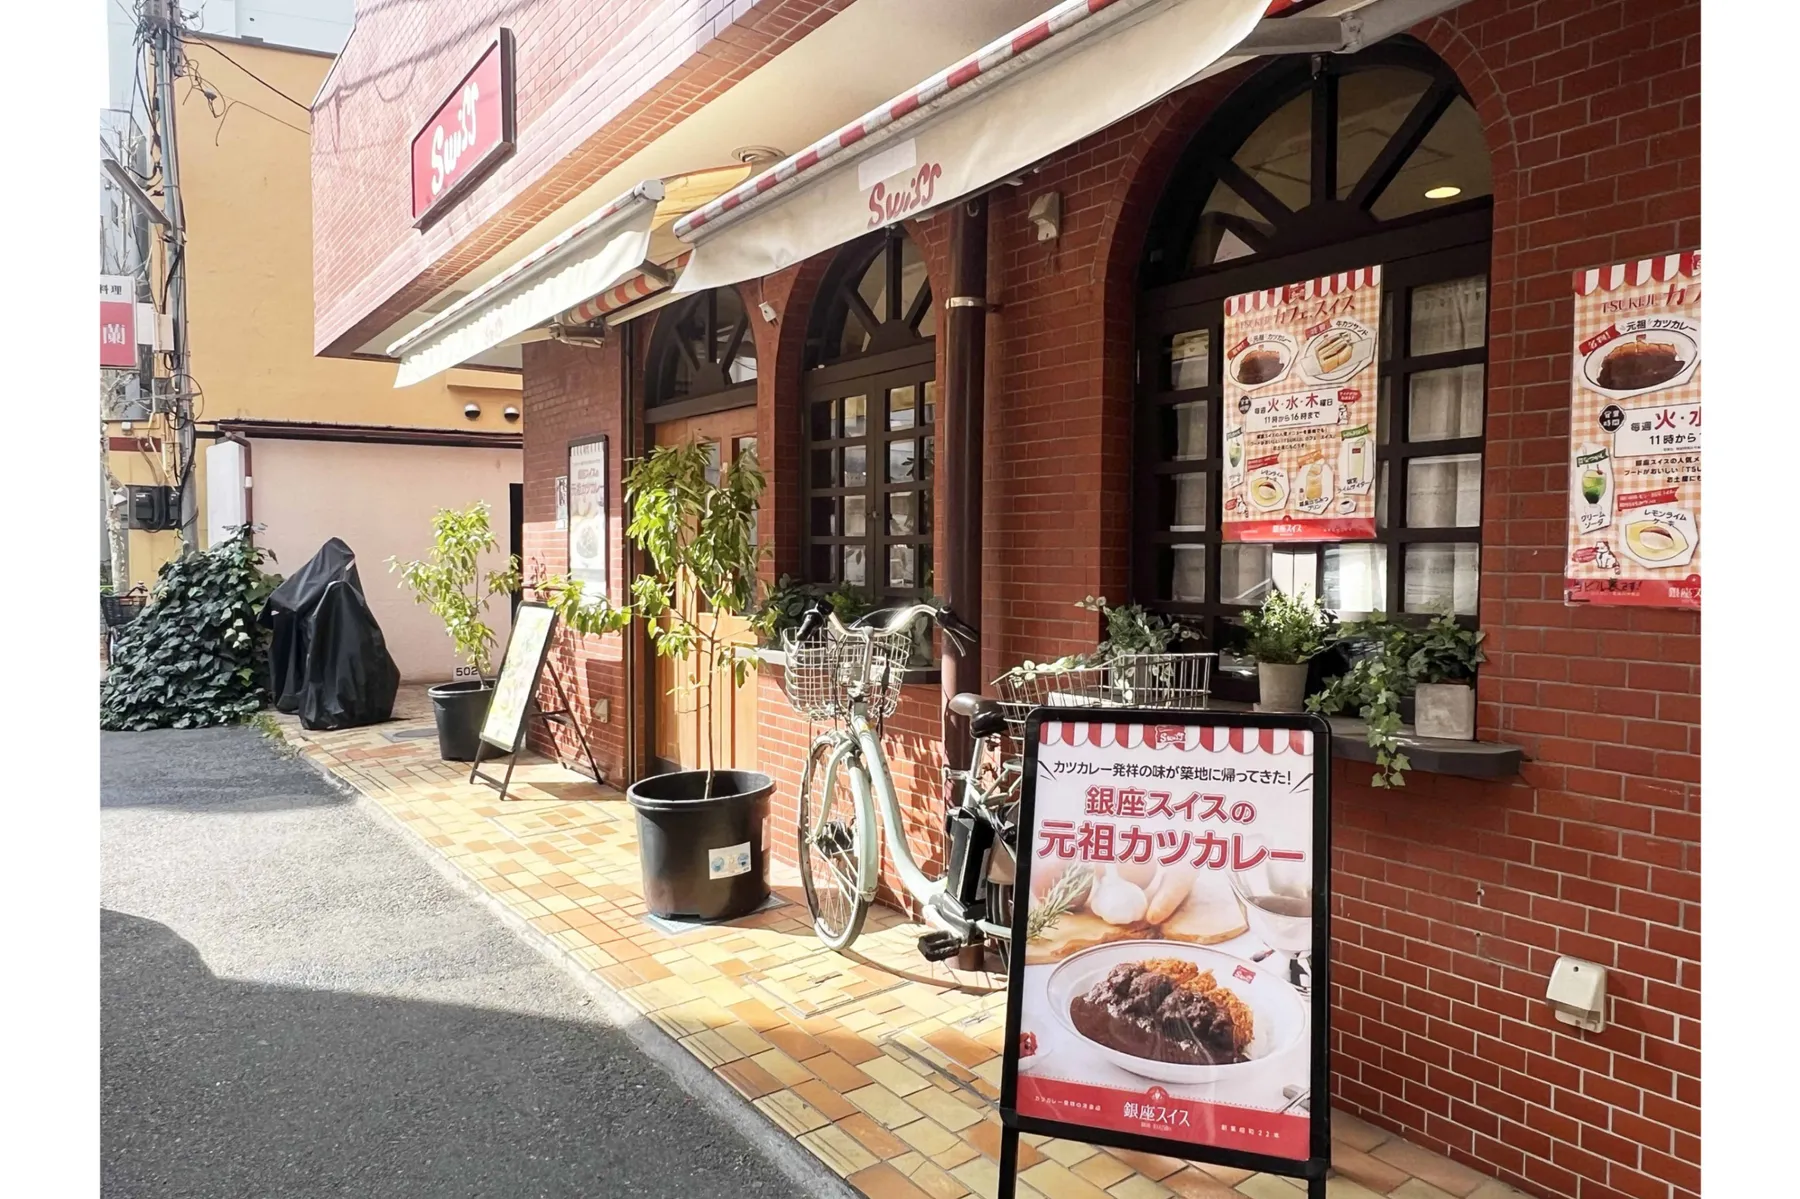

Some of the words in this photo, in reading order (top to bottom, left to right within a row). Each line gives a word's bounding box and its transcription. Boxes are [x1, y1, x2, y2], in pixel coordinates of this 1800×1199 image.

[431, 82, 479, 195] Swiss
[867, 163, 942, 229] Swiss
[1602, 294, 1655, 314] TSUKIJI
[1652, 319, 1697, 332] カツカレー
[1649, 432, 1701, 445] 11時から
[1581, 512, 1606, 522] クリーム
[1585, 519, 1604, 529] ソーダ
[1644, 509, 1687, 521] レモンライム
[456, 666, 478, 677] 502
[1053, 760, 1292, 785] カツカレー発祥の味が築地に帰ってきた!
[1085, 786, 1256, 824] 銀座スイスの
[1037, 820, 1305, 871] 元祖カツカレー
[1123, 1101, 1191, 1128] 銀座スイス
